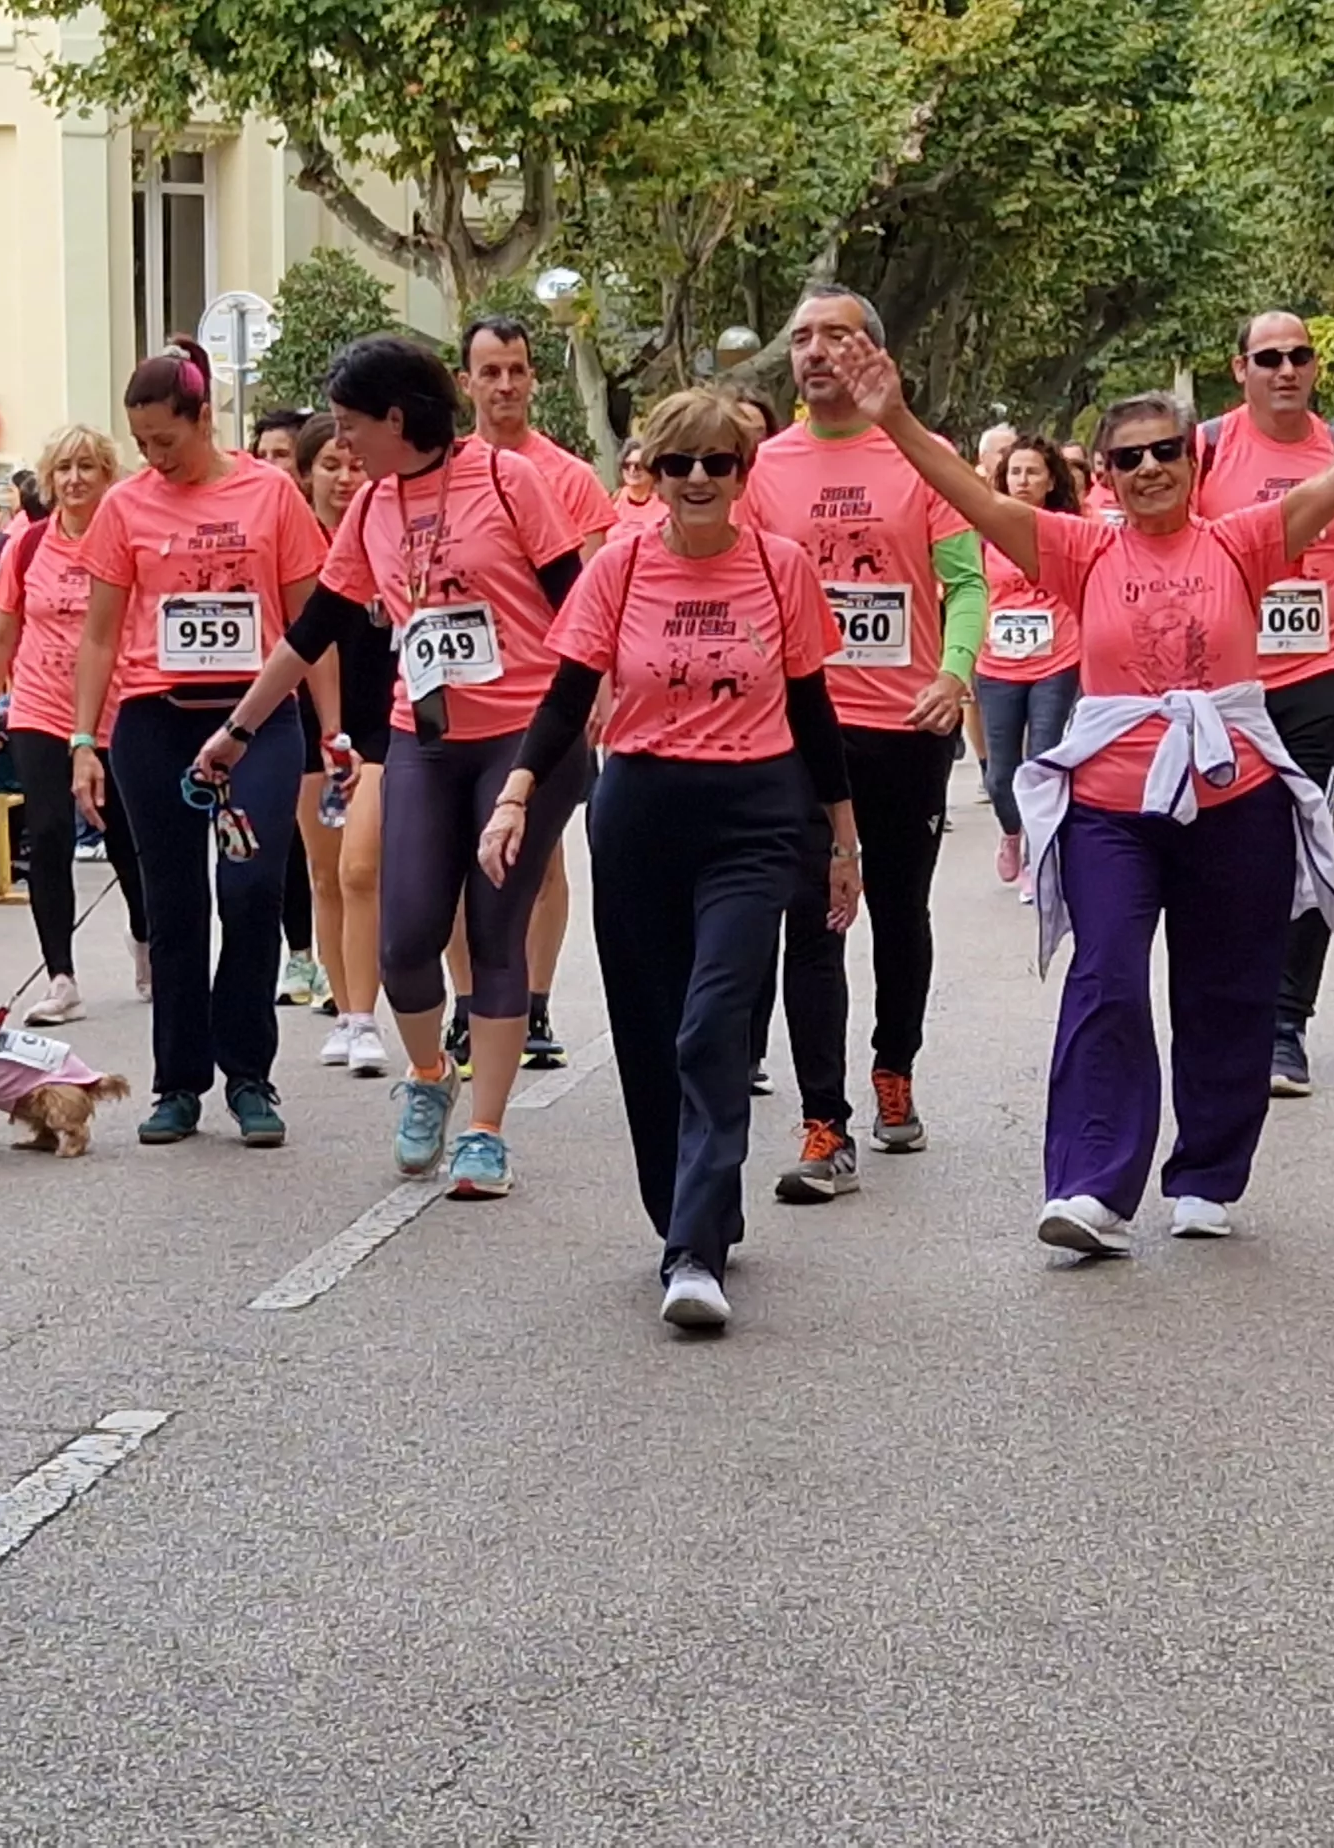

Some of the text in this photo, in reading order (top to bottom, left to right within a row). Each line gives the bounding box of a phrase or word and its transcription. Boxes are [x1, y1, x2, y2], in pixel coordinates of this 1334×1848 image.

[178, 620, 241, 648] 959
[1001, 626, 1038, 645] 431
[416, 632, 475, 668] 949
